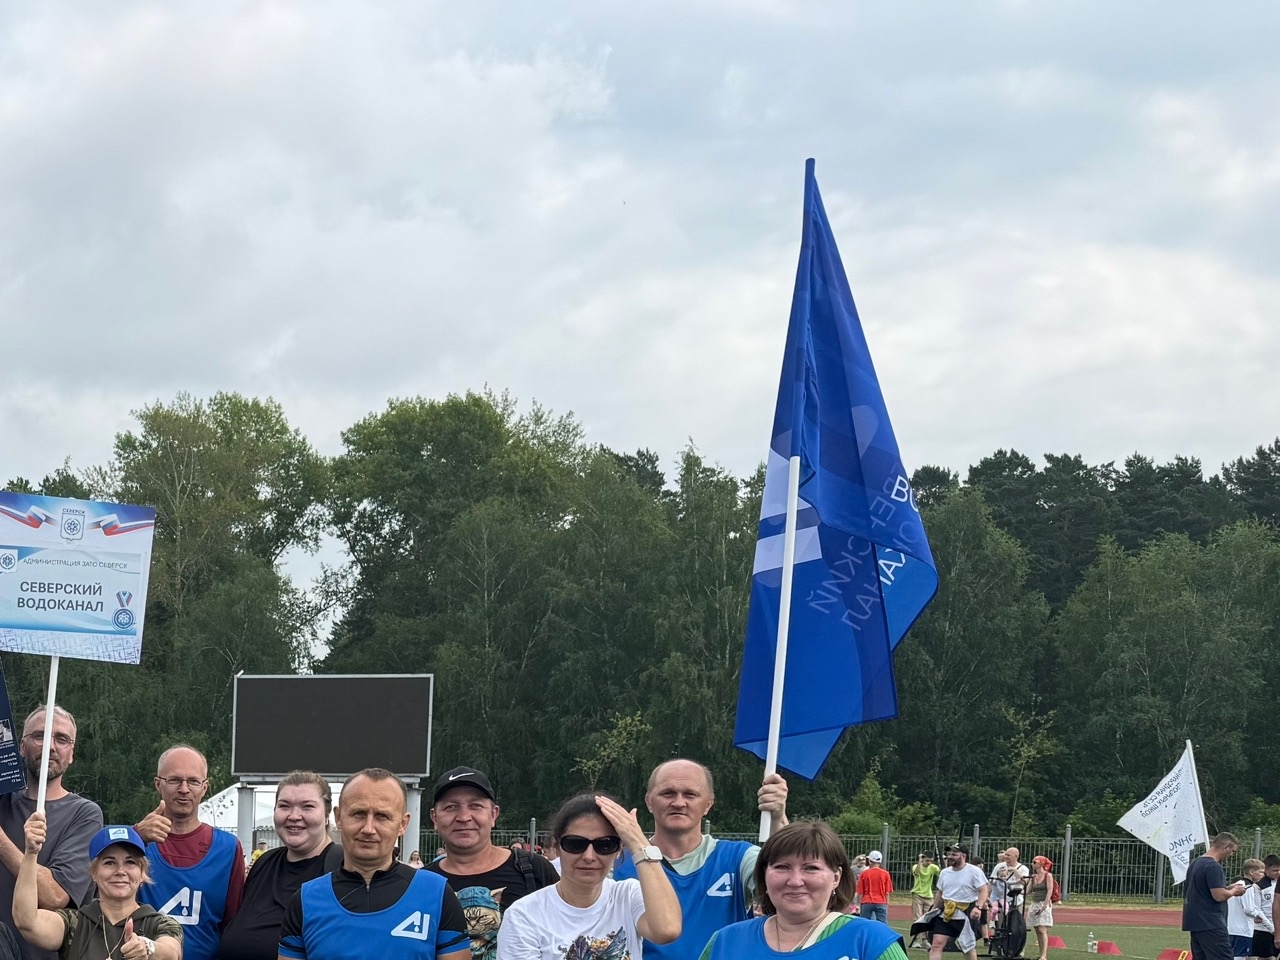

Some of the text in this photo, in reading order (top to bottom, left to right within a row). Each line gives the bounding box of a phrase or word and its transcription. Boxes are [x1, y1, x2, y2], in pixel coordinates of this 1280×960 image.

[23, 559, 128, 569] АДМИНИСТРАЦИЯ ЗАТО СЕВЕРСК
[20, 581, 102, 596] СЕВЕРСКИЙ
[17, 597, 104, 612] ВОДОКАНАЛ
